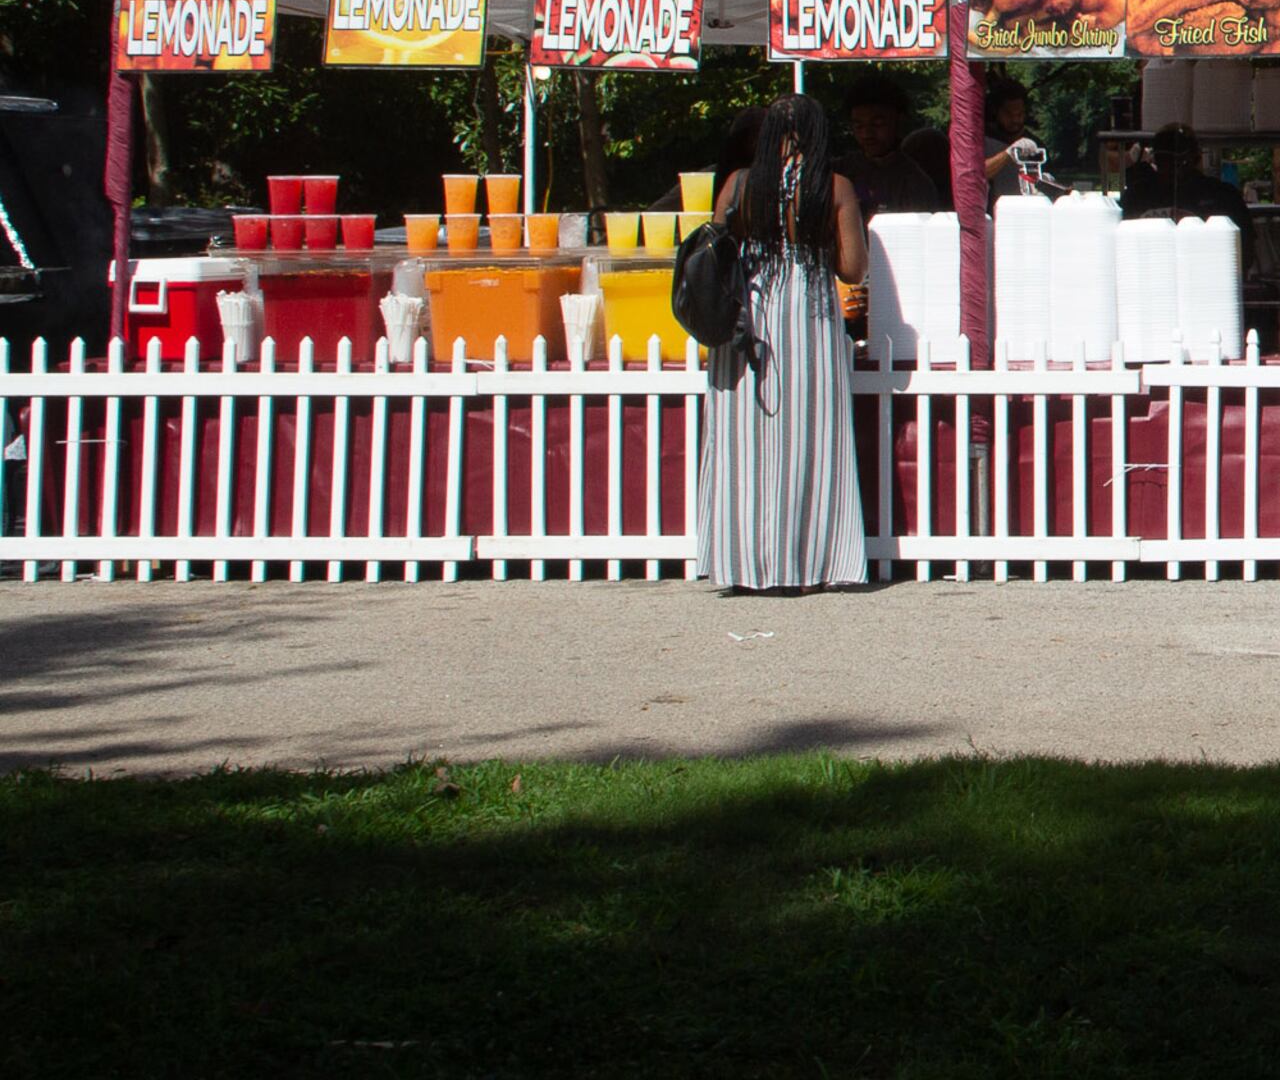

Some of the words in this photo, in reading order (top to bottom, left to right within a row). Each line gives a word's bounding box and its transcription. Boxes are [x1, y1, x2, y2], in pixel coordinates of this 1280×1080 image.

[976, 19, 1020, 49] Fried
[1020, 19, 1068, 52] Jumbo
[1070, 19, 1119, 54] Shrimp
[1155, 17, 1216, 47] Fried
[1220, 16, 1269, 46] Fish
